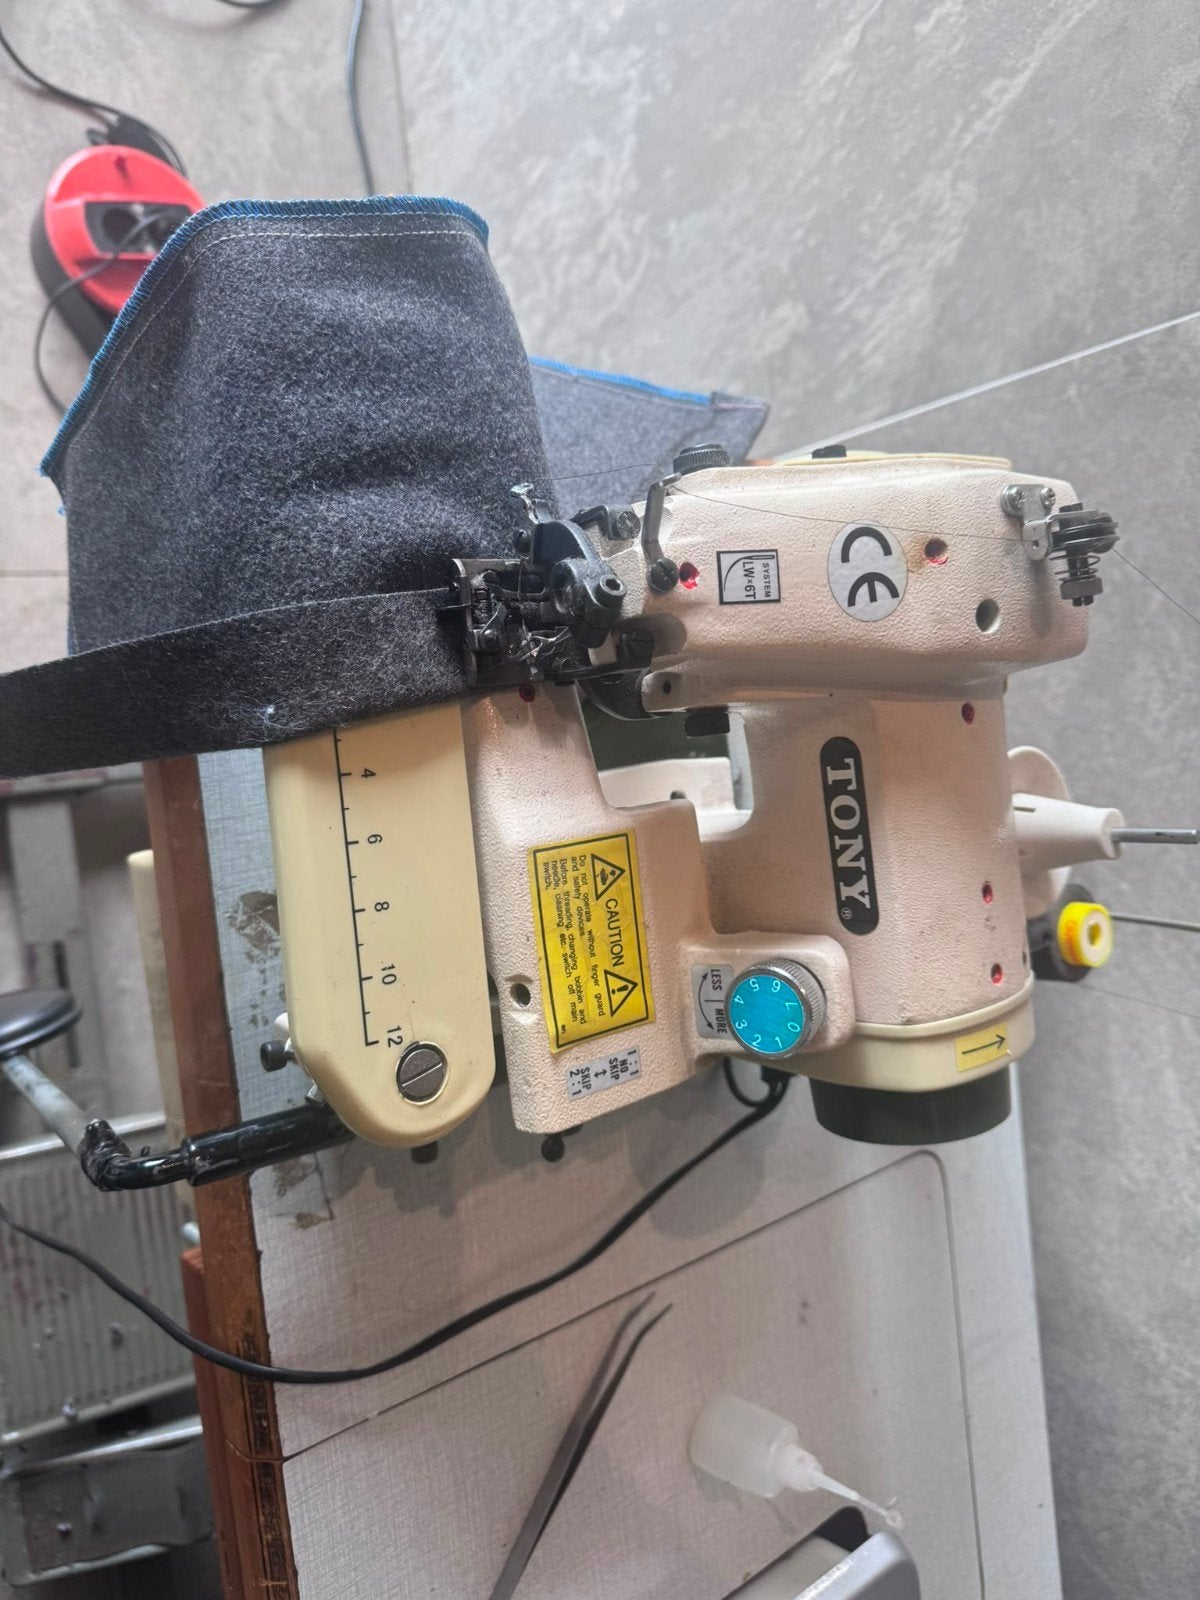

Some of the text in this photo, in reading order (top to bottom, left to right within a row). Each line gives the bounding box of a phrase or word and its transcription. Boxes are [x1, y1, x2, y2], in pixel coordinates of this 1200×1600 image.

[762, 562, 771, 598] SYSTEM
[841, 526, 900, 607] CE
[827, 757, 871, 909] TONY
[571, 856, 579, 872] and
[580, 855, 587, 867] Do
[573, 876, 581, 900] safety
[361, 768, 404, 1048] 4 6 8 10 12
[583, 893, 592, 922] operate
[555, 893, 564, 928] cleaning
[562, 952, 572, 978] switch
[568, 984, 576, 995] off
[560, 858, 568, 885] Before
[568, 933, 578, 971] changing
[575, 976, 583, 1004] bobbin
[579, 1009, 587, 1025] and
[588, 929, 597, 957] without
[605, 898, 625, 967] CAUTION
[591, 964, 600, 987] finger
[711, 969, 722, 991] LESS
[594, 993, 605, 1017] guard
[734, 978, 800, 1049] 0 1 2 3 4 5 6 7
[715, 1008, 727, 1034] MORE
[581, 1066, 592, 1090] SKIP
[609, 1057, 620, 1081] SKIP
[619, 1058, 629, 1074] NO
